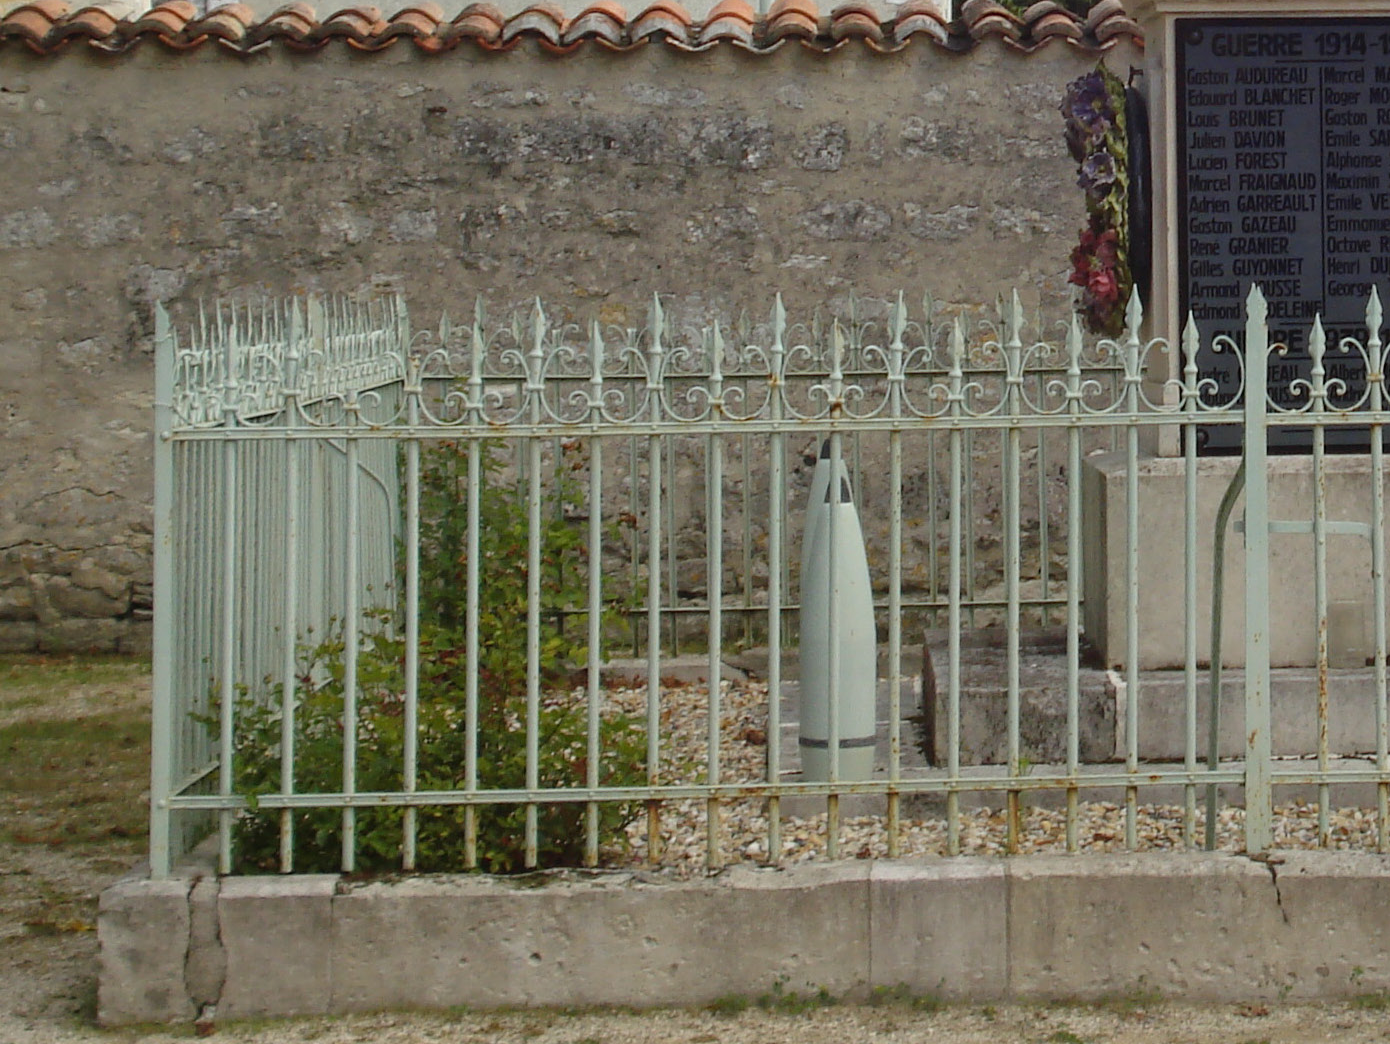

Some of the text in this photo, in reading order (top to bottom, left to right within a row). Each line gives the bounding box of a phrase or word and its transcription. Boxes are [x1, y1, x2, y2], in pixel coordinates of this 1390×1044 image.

[1212, 32, 1303, 57] GUERRE
[1187, 66, 1308, 85] Gaston AUDUREAU
[1325, 66, 1365, 84] Marcel
[1244, 87, 1316, 105] BLANCHET
[1325, 87, 1361, 107] Roger
[1188, 109, 1285, 127] Louis BRUNET
[1325, 108, 1367, 126] Gaston
[1189, 130, 1286, 149] Julien DAVION
[1189, 151, 1288, 171] Lucien FOREST
[1326, 151, 1382, 170] Alphonse
[1189, 173, 1316, 192] Marcel FRAIGNAUD
[1326, 172, 1380, 190] Maximin
[1189, 194, 1317, 213] Adrien GARREAULT
[1190, 216, 1297, 235] Gaston GAZEAU
[1228, 237, 1289, 255] GRANIER
[1327, 236, 1371, 254] Octave
[1190, 257, 1304, 277] Gilles GUYONNET
[1327, 257, 1360, 275] Henri
[1190, 280, 1240, 298] Armand
[1328, 279, 1373, 297] George
[1191, 302, 1241, 320] Edmond
